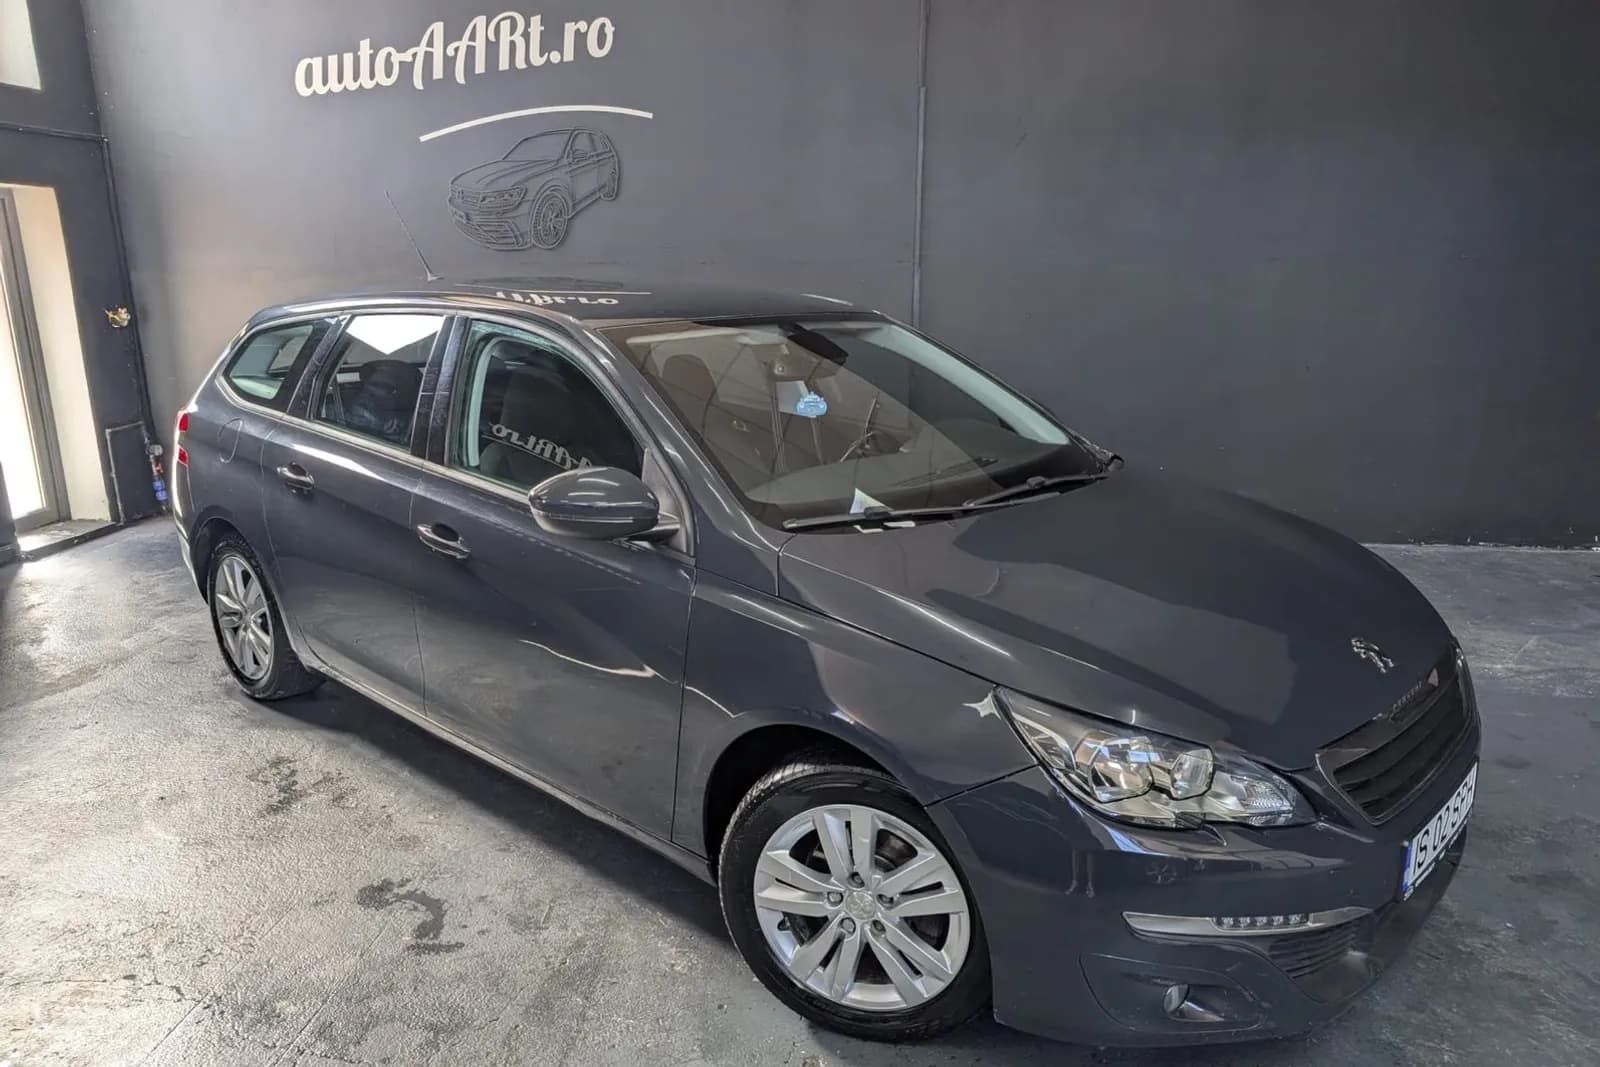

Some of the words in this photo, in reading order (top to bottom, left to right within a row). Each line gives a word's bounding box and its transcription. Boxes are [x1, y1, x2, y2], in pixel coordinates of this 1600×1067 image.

[295, 11, 615, 97] autoAARt.ro
[1413, 830, 1430, 875] IS
[1433, 807, 1450, 850] 02
